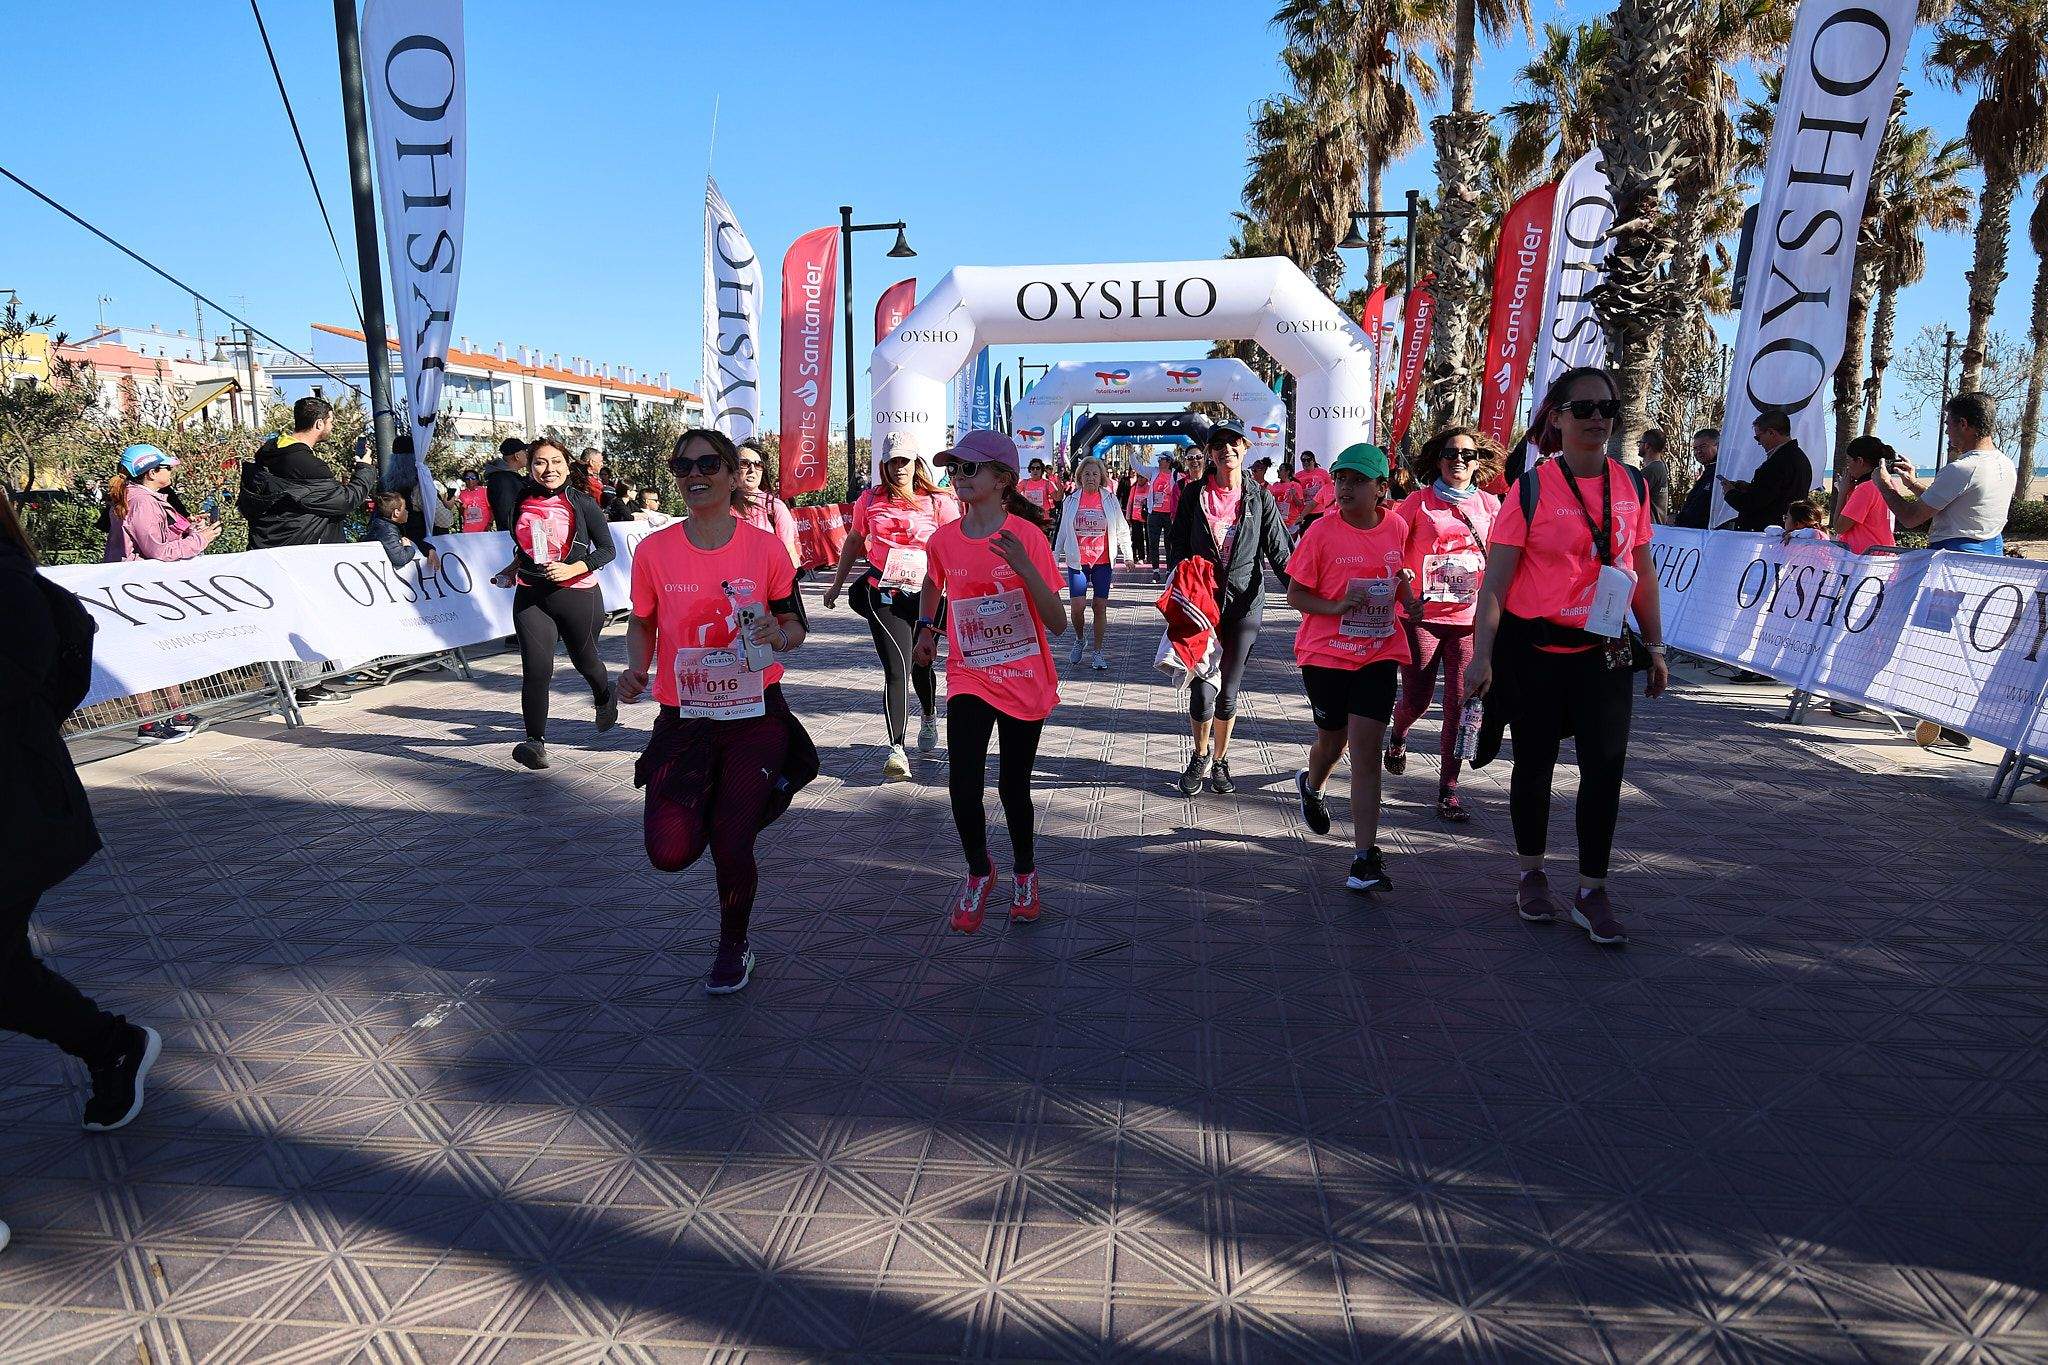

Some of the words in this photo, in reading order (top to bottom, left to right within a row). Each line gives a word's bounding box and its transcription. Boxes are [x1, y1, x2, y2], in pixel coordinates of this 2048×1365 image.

[1746, 7, 1891, 415] OYSHO
[1502, 221, 1543, 358] Santander
[1016, 277, 1218, 322] OYSHO
[799, 262, 822, 376] Santander
[1276, 319, 1338, 334] OYSHO
[900, 330, 959, 343] OYSHO
[1401, 299, 1430, 392] Santander
[876, 410, 929, 424] OYSHO
[1309, 405, 1366, 420] OYSHO
[1110, 419, 1181, 428] VOLVO
[794, 411, 816, 478] Sports
[1335, 556, 1364, 564] OYSHO
[1443, 575, 1463, 584] 016
[664, 583, 699, 593] OYSHO
[1736, 558, 1885, 633] OYSHO
[73, 574, 275, 627] YSHO
[1367, 605, 1389, 615] 016
[983, 623, 1013, 639] 016
[706, 678, 739, 693] 016
